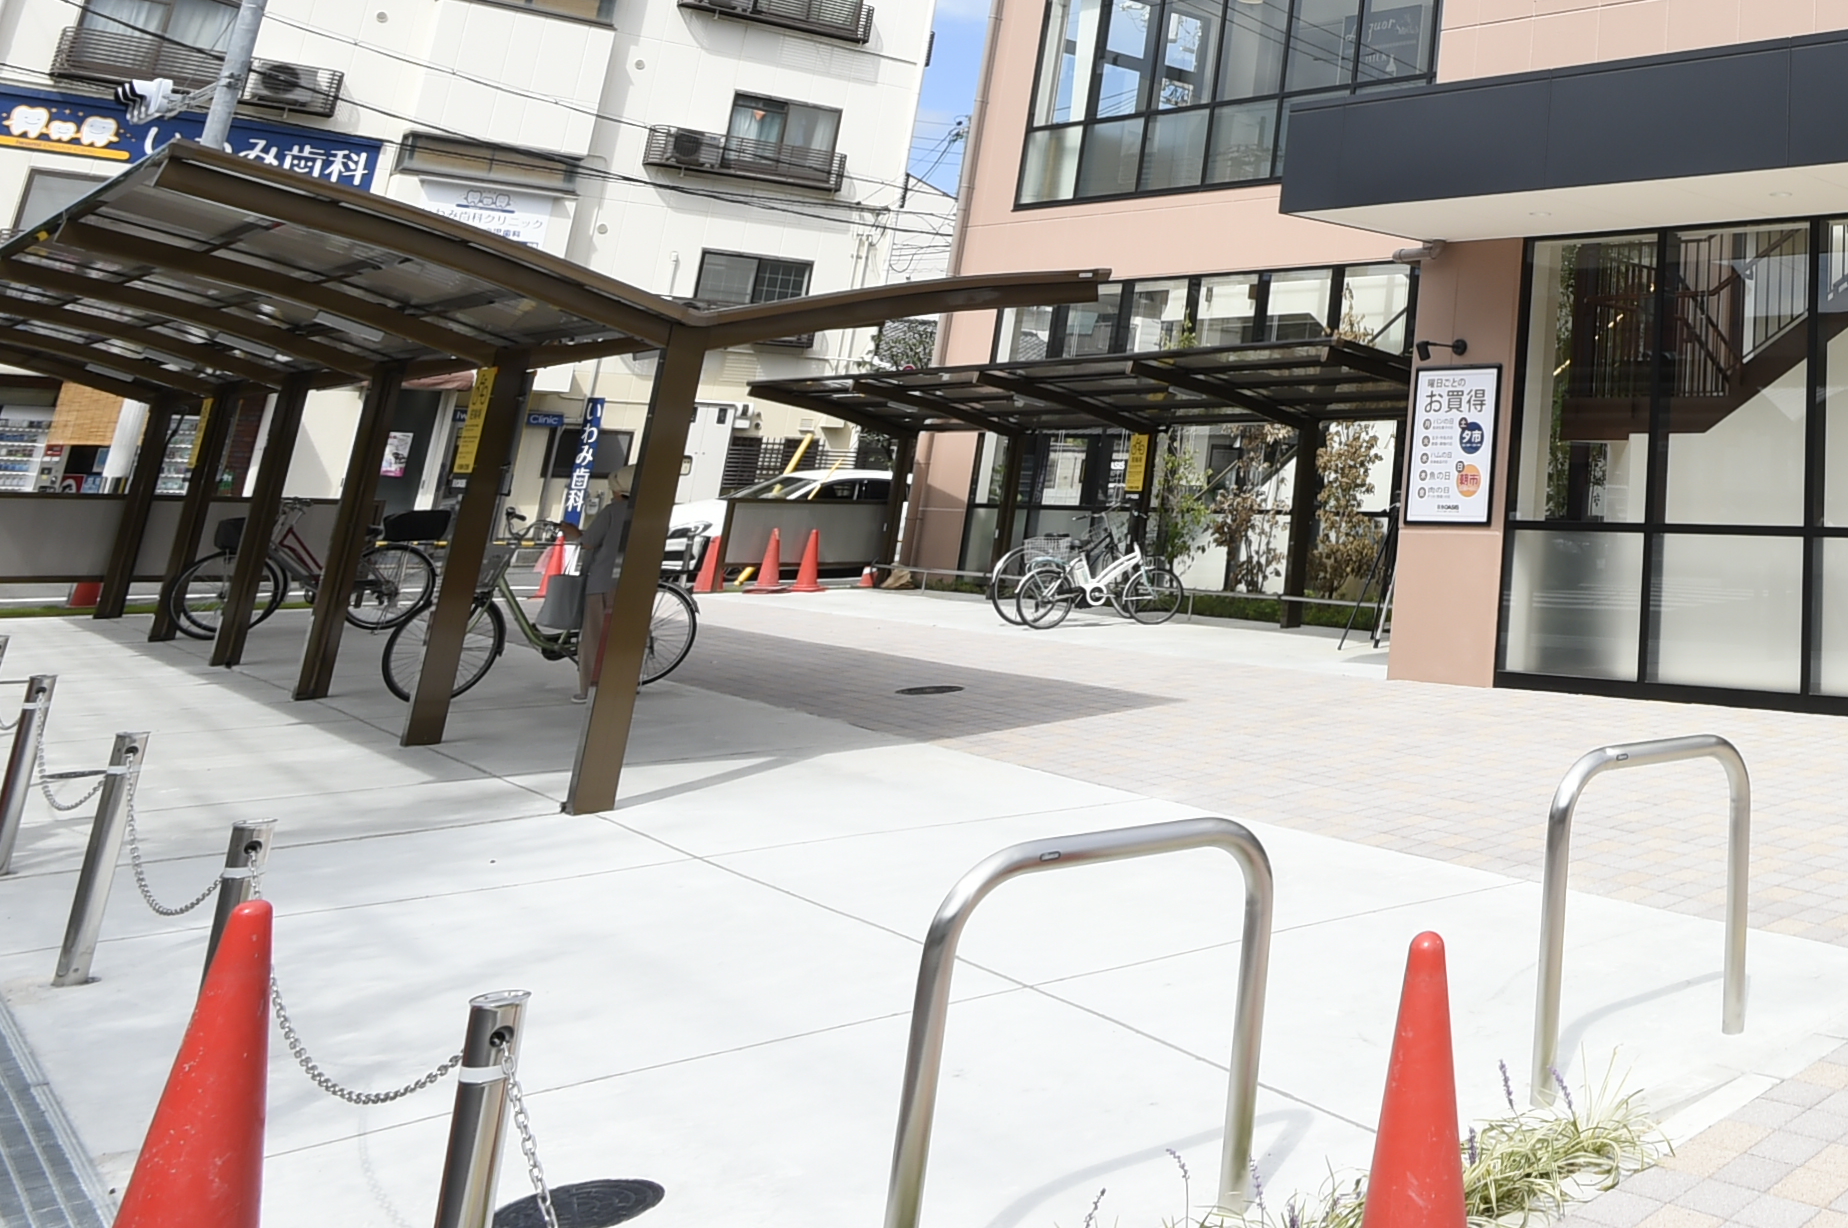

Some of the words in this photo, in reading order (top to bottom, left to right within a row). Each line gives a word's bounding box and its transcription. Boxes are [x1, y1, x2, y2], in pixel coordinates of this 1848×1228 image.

[1427, 378, 1466, 388] 曜日ごとの
[1424, 389, 1487, 413] お買得
[529, 414, 560, 425] Clinic
[566, 402, 602, 512] いわみ歯科
